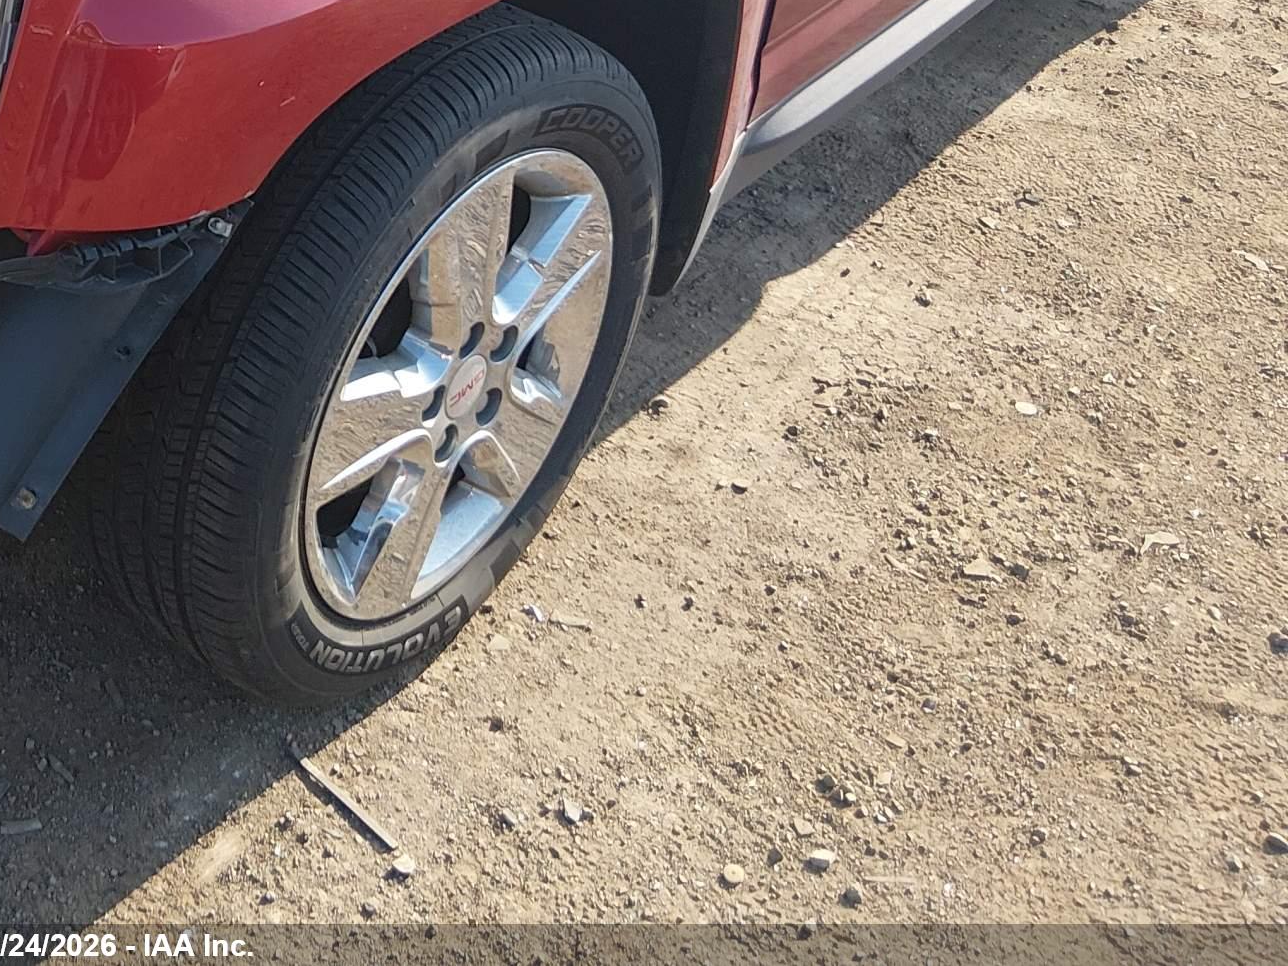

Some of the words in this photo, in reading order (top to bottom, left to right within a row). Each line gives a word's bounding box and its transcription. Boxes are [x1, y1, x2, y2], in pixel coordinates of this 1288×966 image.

[539, 107, 644, 168] COOPER
[450, 369, 484, 408] GMC
[309, 605, 462, 673] EVOLUTION
